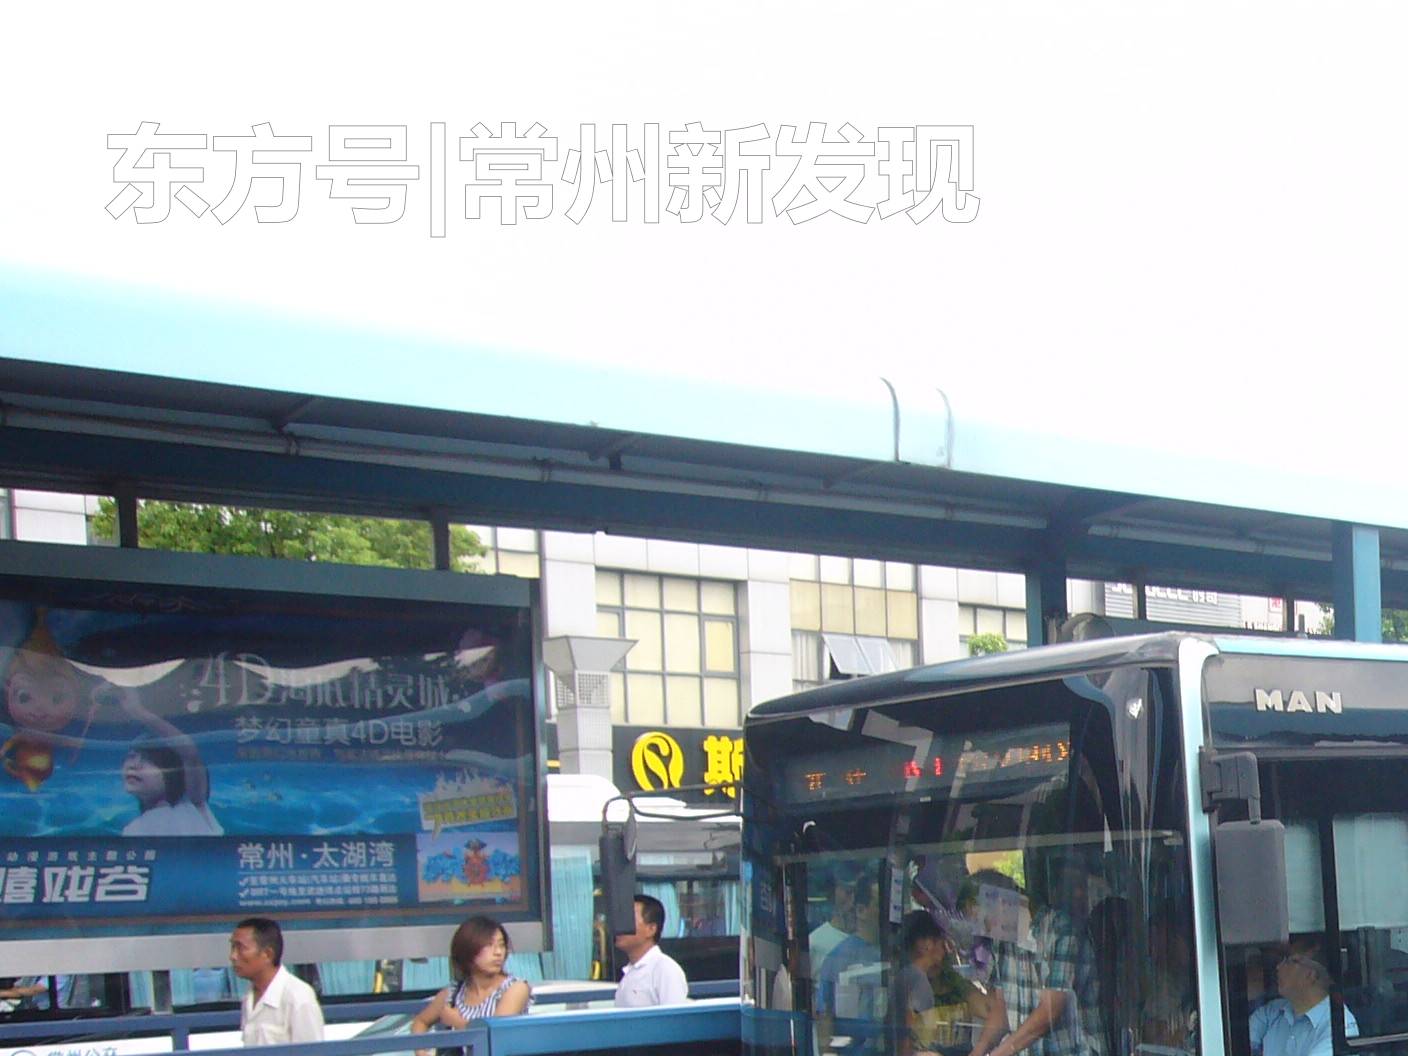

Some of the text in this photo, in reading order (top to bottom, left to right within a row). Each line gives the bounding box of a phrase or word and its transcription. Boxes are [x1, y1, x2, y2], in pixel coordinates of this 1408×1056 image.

[1254, 687, 1343, 715] MAN
[234, 714, 444, 747] 梦幻童真4D电影
[238, 841, 396, 870] 常州·太湖湾
